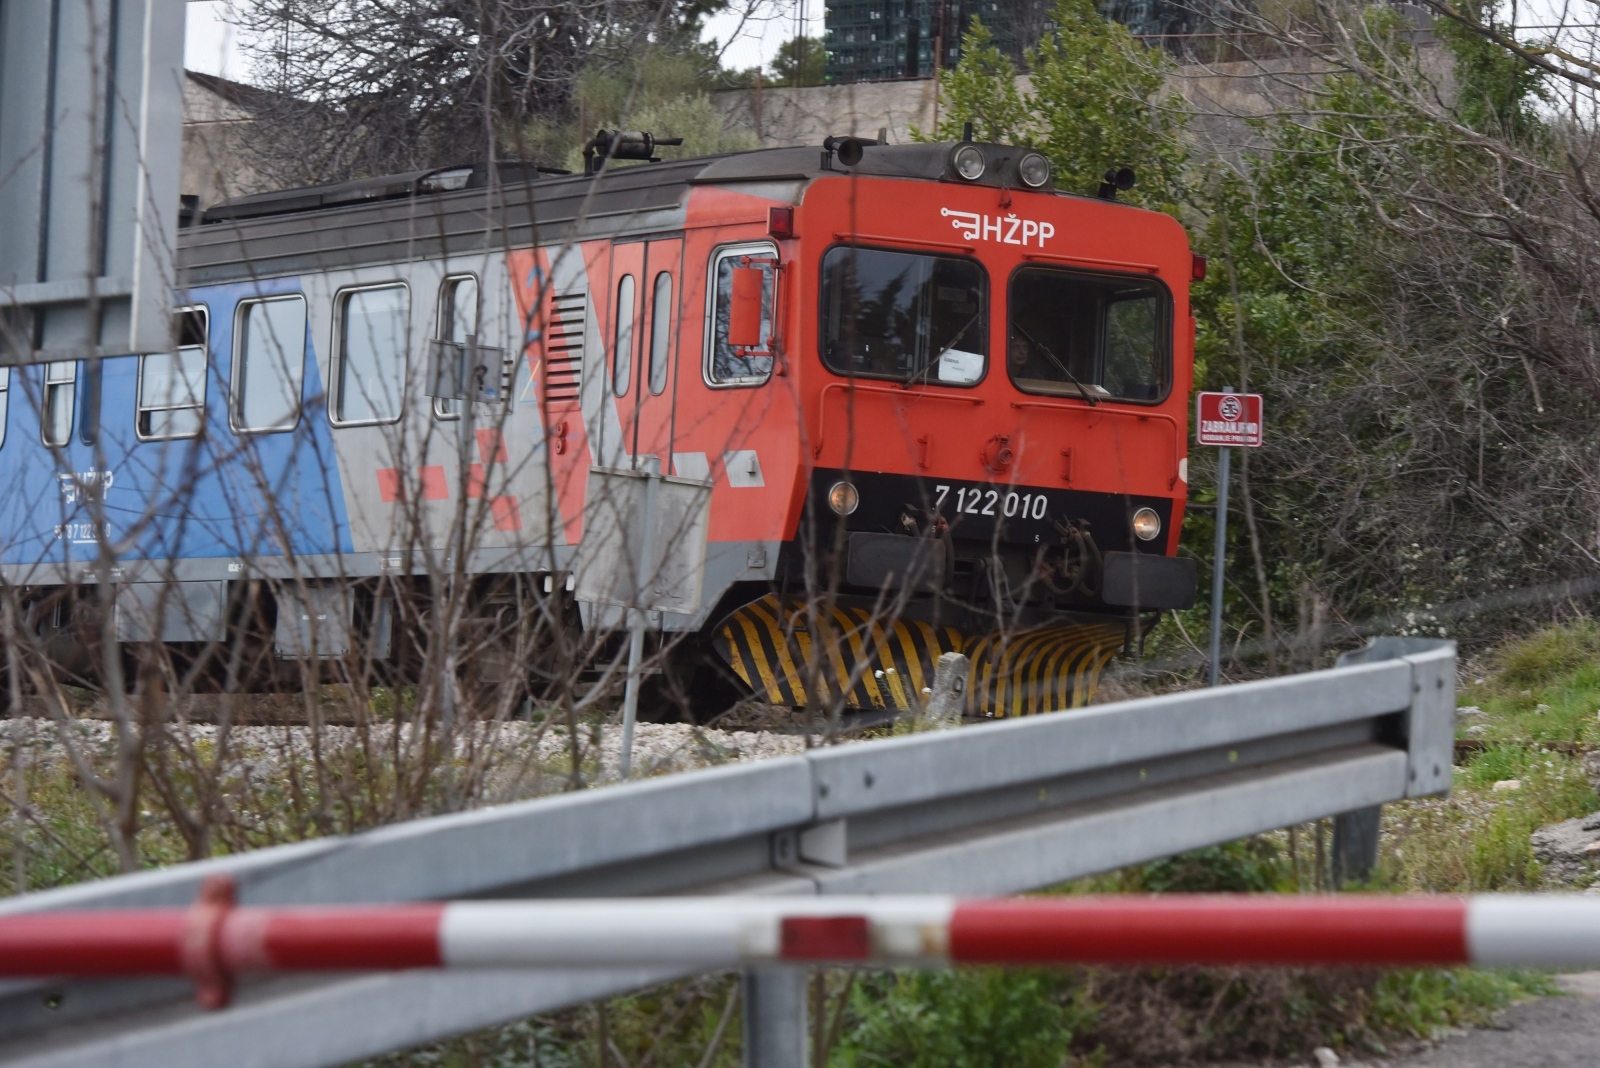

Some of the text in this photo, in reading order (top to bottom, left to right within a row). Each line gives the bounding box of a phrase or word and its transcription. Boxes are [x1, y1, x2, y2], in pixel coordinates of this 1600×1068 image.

[983, 213, 1055, 248] HŽPP
[935, 485, 1048, 520] 7 122 010
